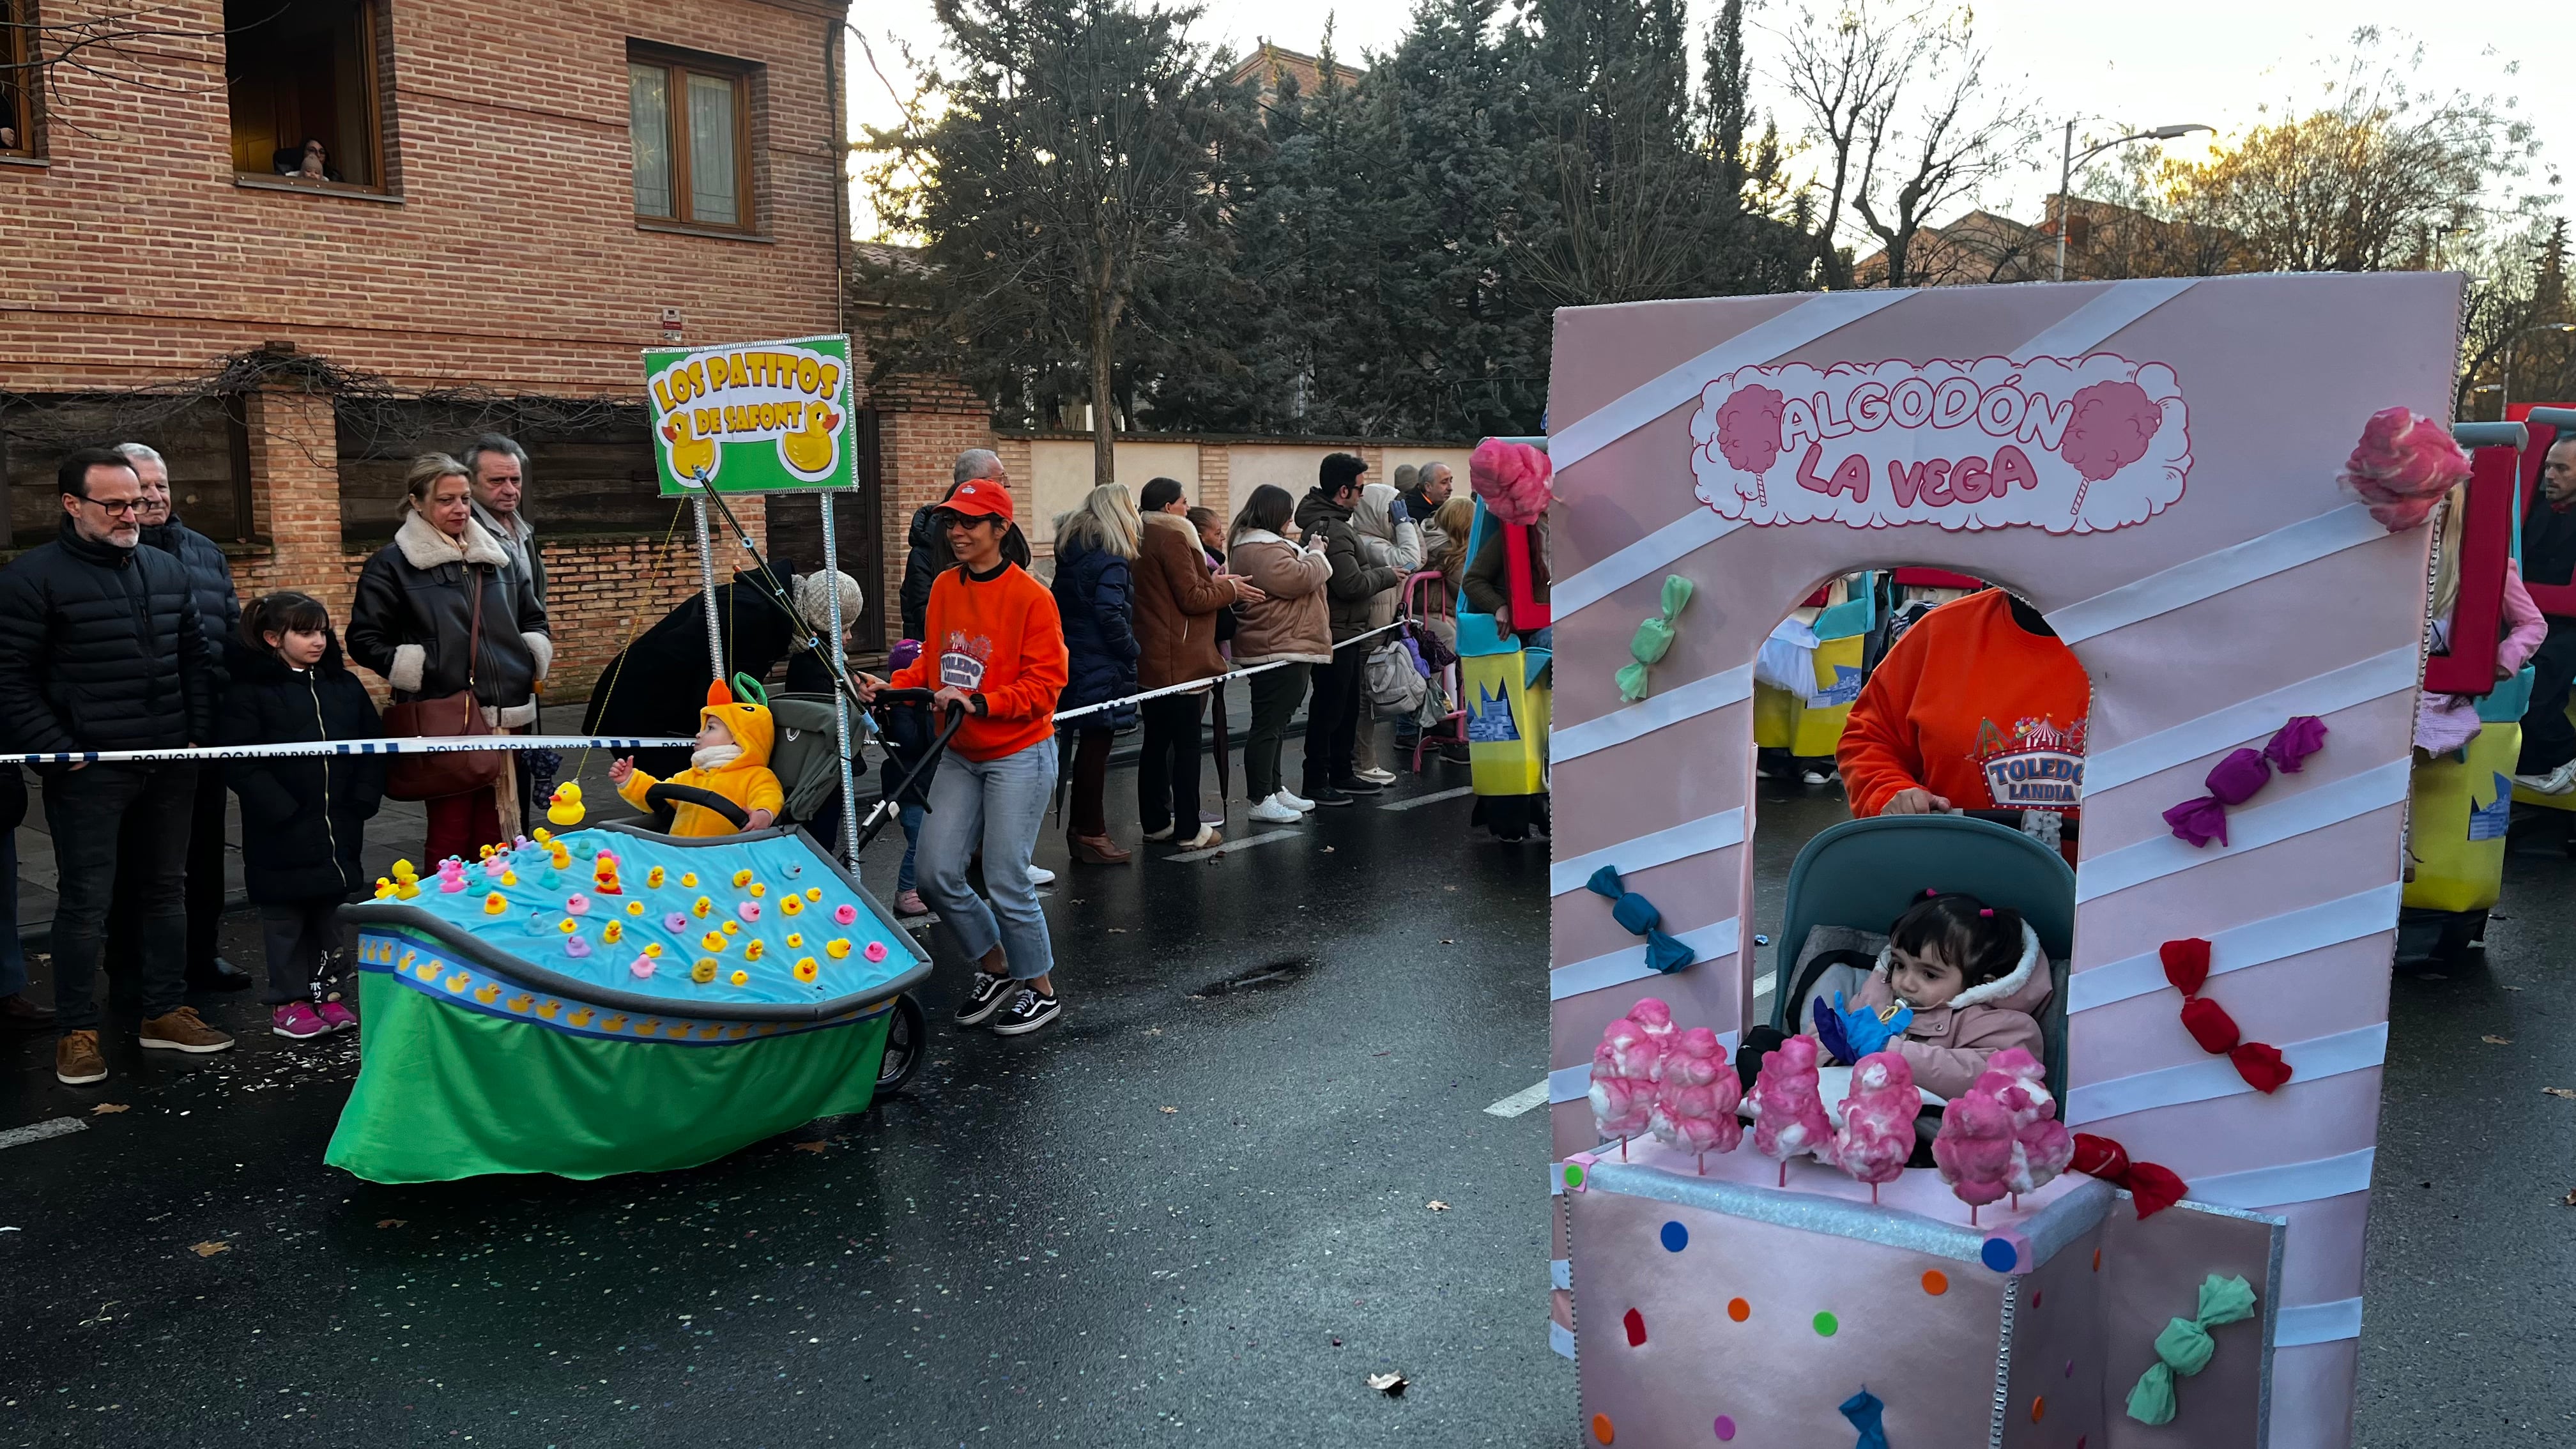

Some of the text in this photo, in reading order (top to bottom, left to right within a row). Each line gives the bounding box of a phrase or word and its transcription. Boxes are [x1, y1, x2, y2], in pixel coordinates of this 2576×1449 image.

[654, 352, 839, 414] LOS PATITOS
[694, 401, 802, 435] DE SAFONT
[1780, 374, 2075, 452] ALGODÓN
[1796, 443, 2037, 508] LA VEGA
[941, 656, 981, 677] TOLEDO
[2009, 783, 2076, 801] LANDIA
